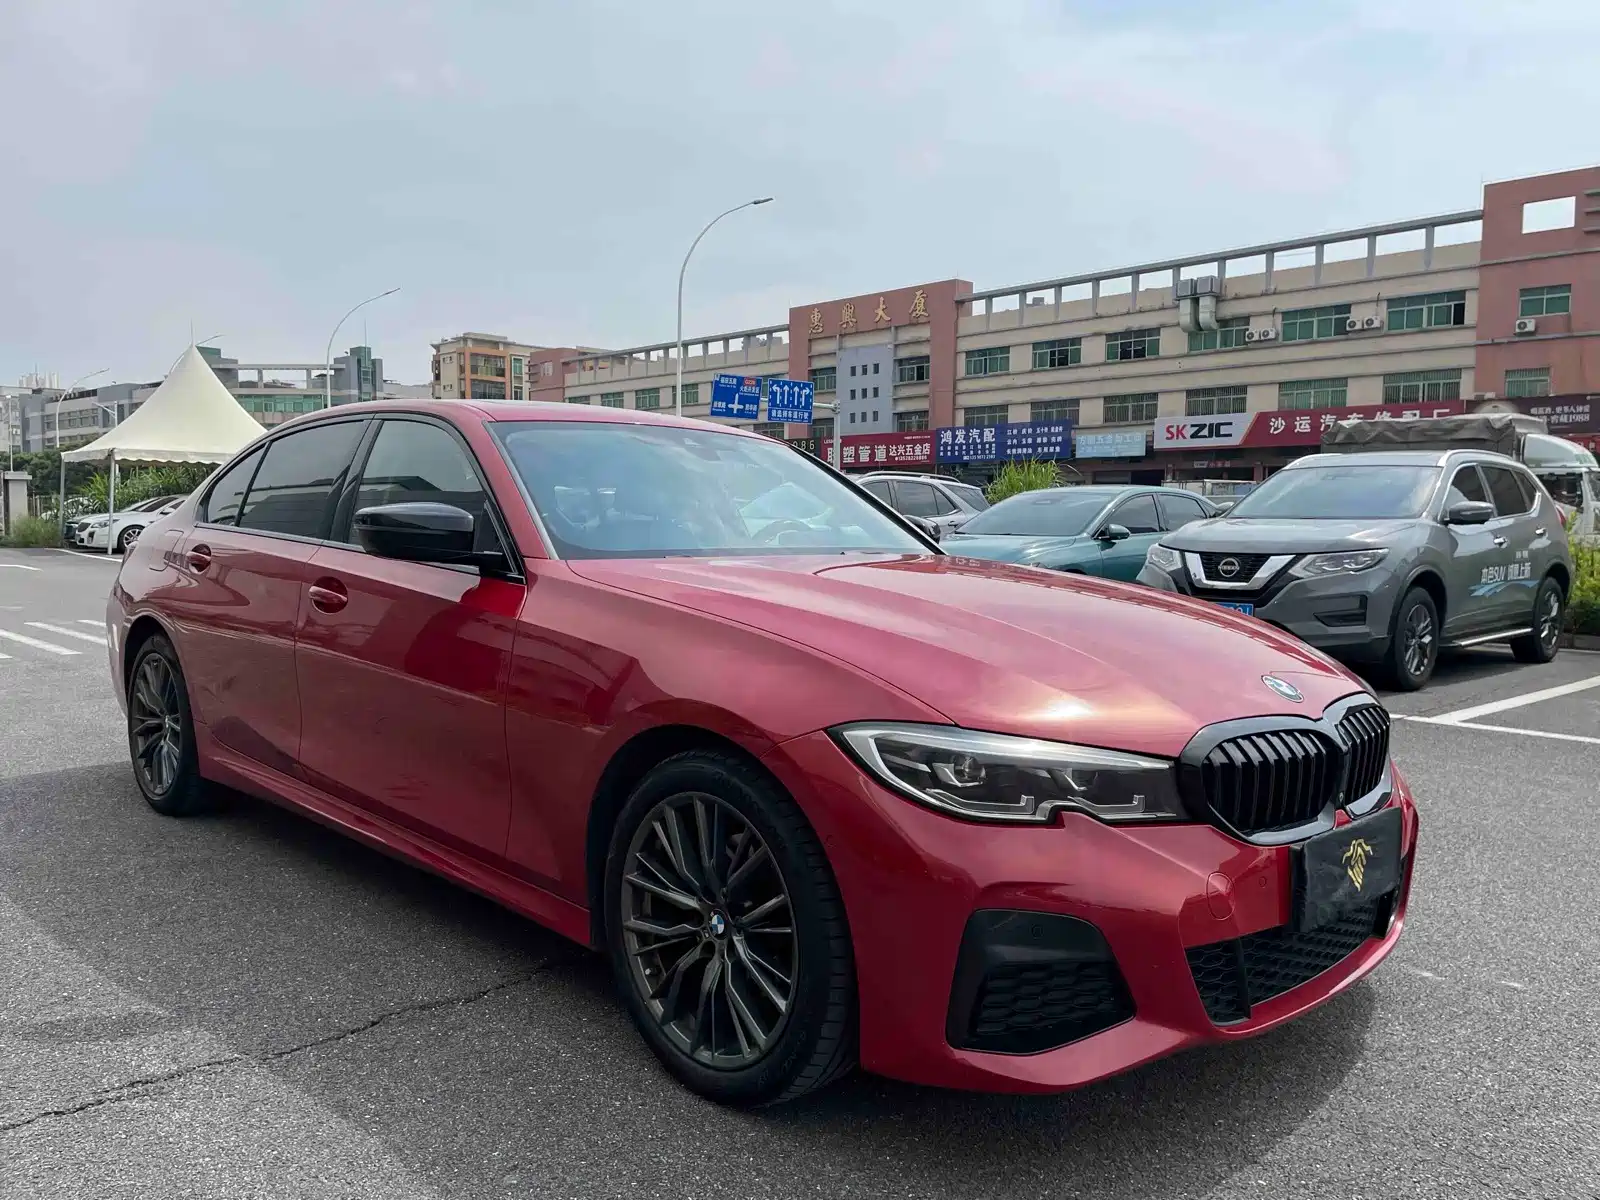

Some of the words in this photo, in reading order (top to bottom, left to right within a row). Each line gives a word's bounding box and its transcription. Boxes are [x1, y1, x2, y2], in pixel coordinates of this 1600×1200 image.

[940, 428, 996, 445] 鸿发汽配
[1165, 424, 1187, 440] SK
[1190, 422, 1233, 439] ZIC
[889, 443, 930, 456] 达兴五金店
